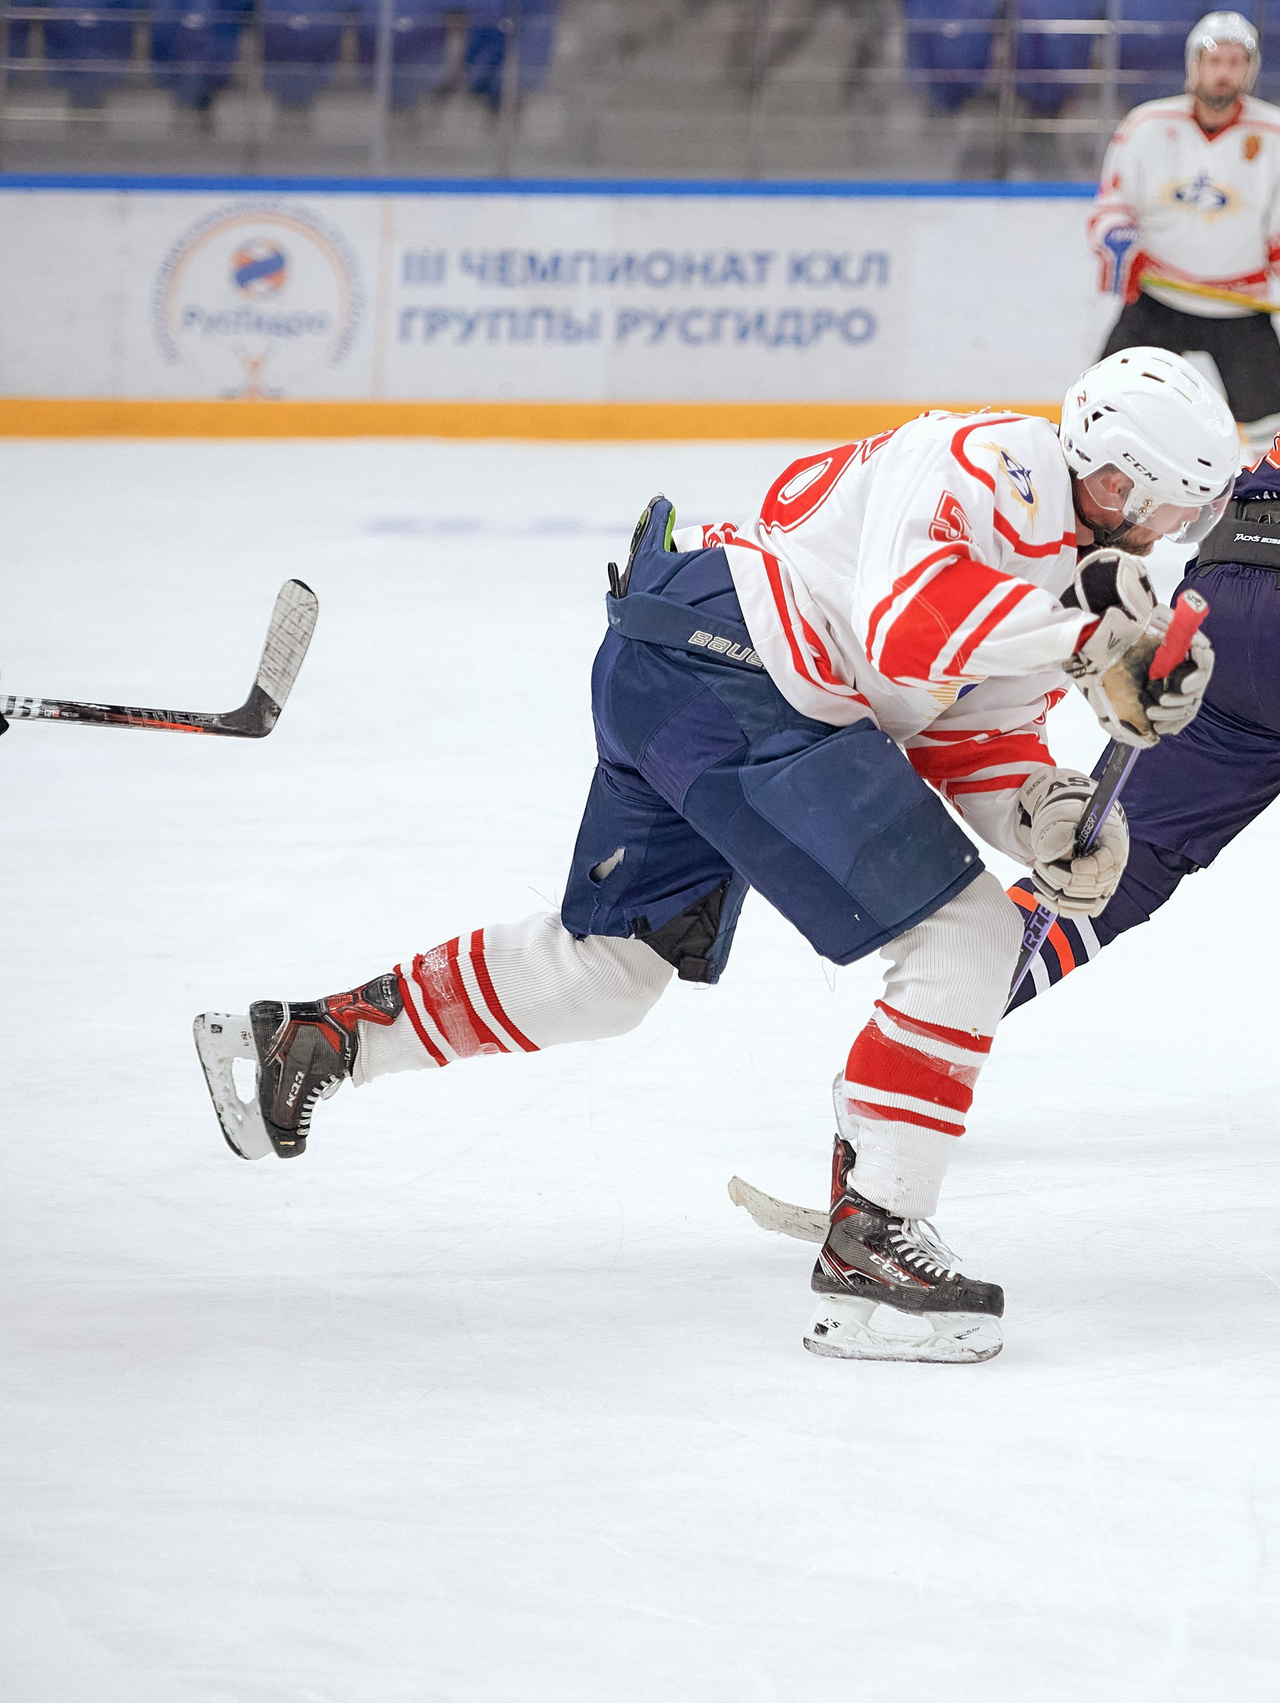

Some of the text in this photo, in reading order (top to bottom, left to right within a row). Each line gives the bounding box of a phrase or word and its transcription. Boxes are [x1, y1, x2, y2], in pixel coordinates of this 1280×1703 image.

[460, 250, 773, 286] ЧЕМПИОНАТ
[787, 250, 889, 285] КХЛ
[400, 306, 878, 349] ГРУППЫ РУСГИДРО
[1122, 452, 1159, 482] CCM
[687, 630, 766, 670] BAUE
[869, 1252, 911, 1283] CCM
